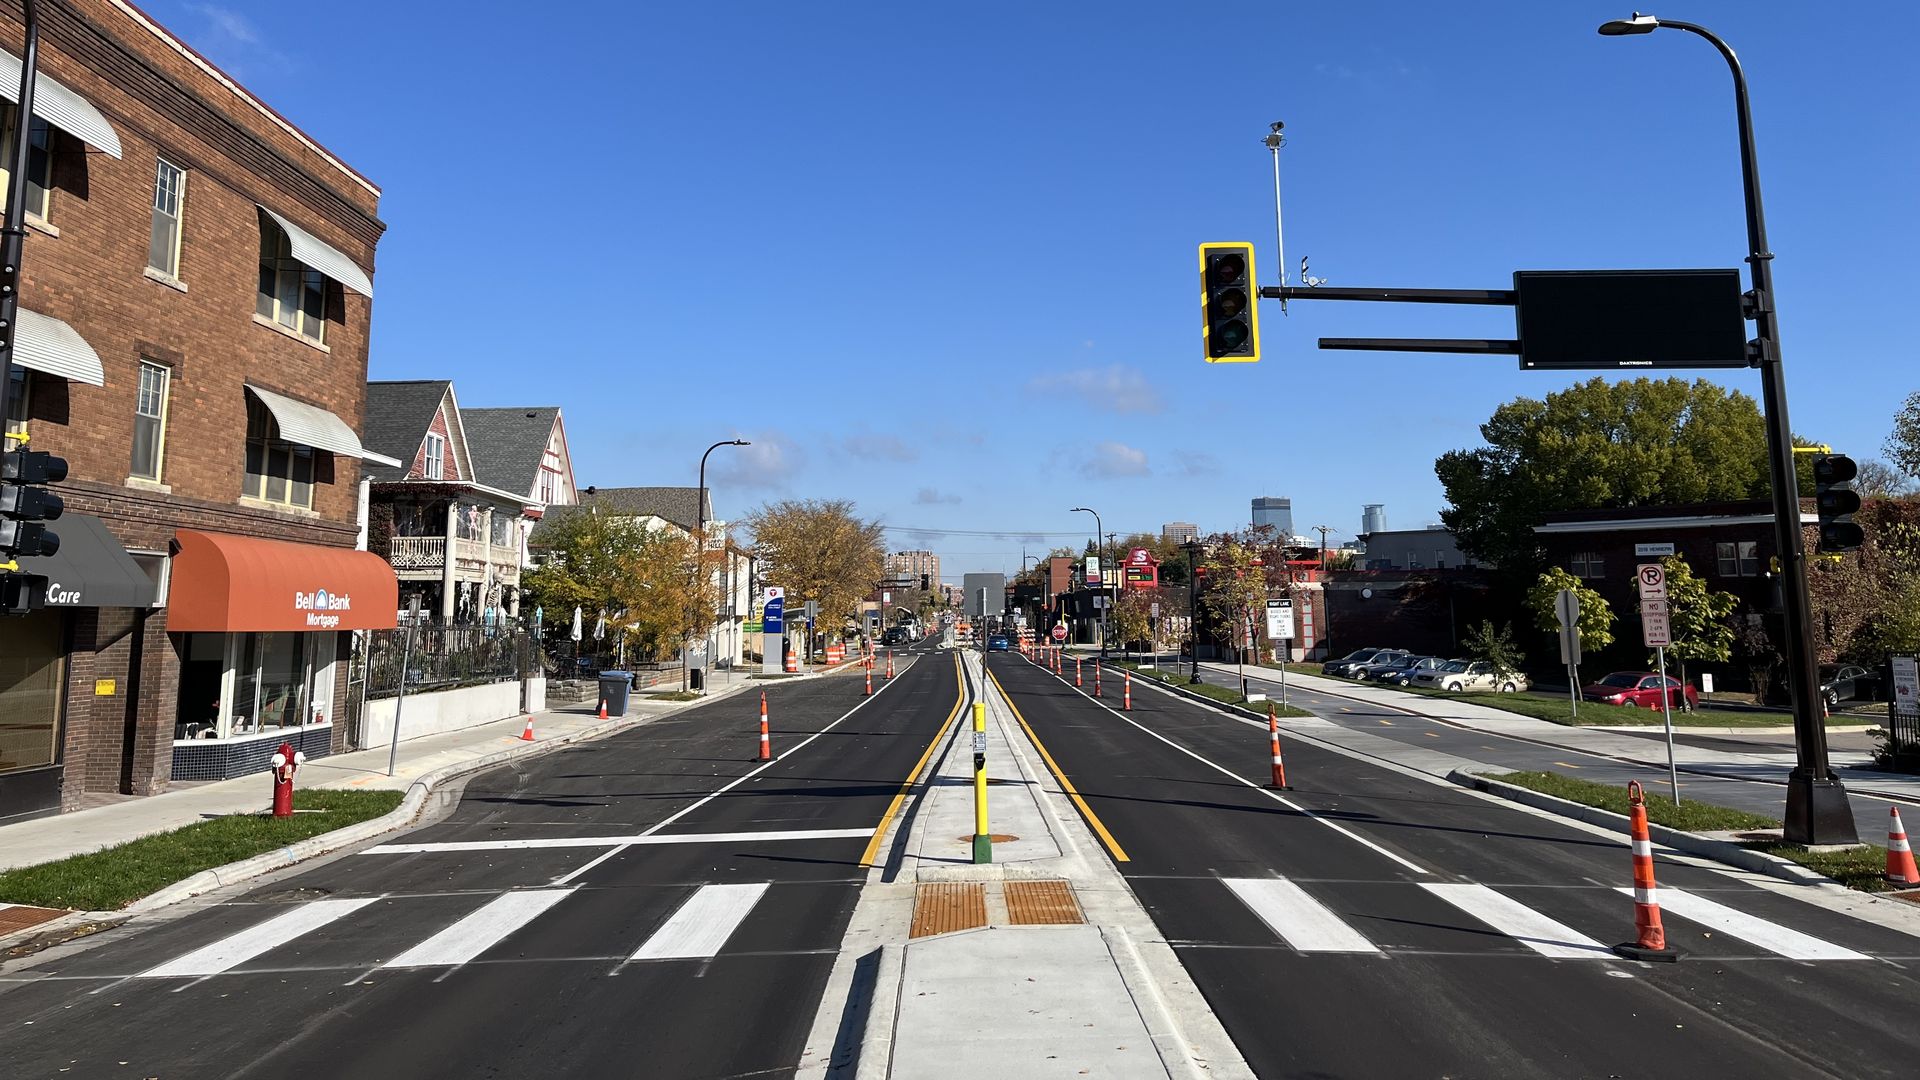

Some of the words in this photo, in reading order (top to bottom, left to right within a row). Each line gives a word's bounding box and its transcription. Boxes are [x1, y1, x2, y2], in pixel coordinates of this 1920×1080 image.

[295, 591, 315, 610] Bell
[328, 593, 351, 610] Bank
[306, 612, 340, 628] Mortgage
